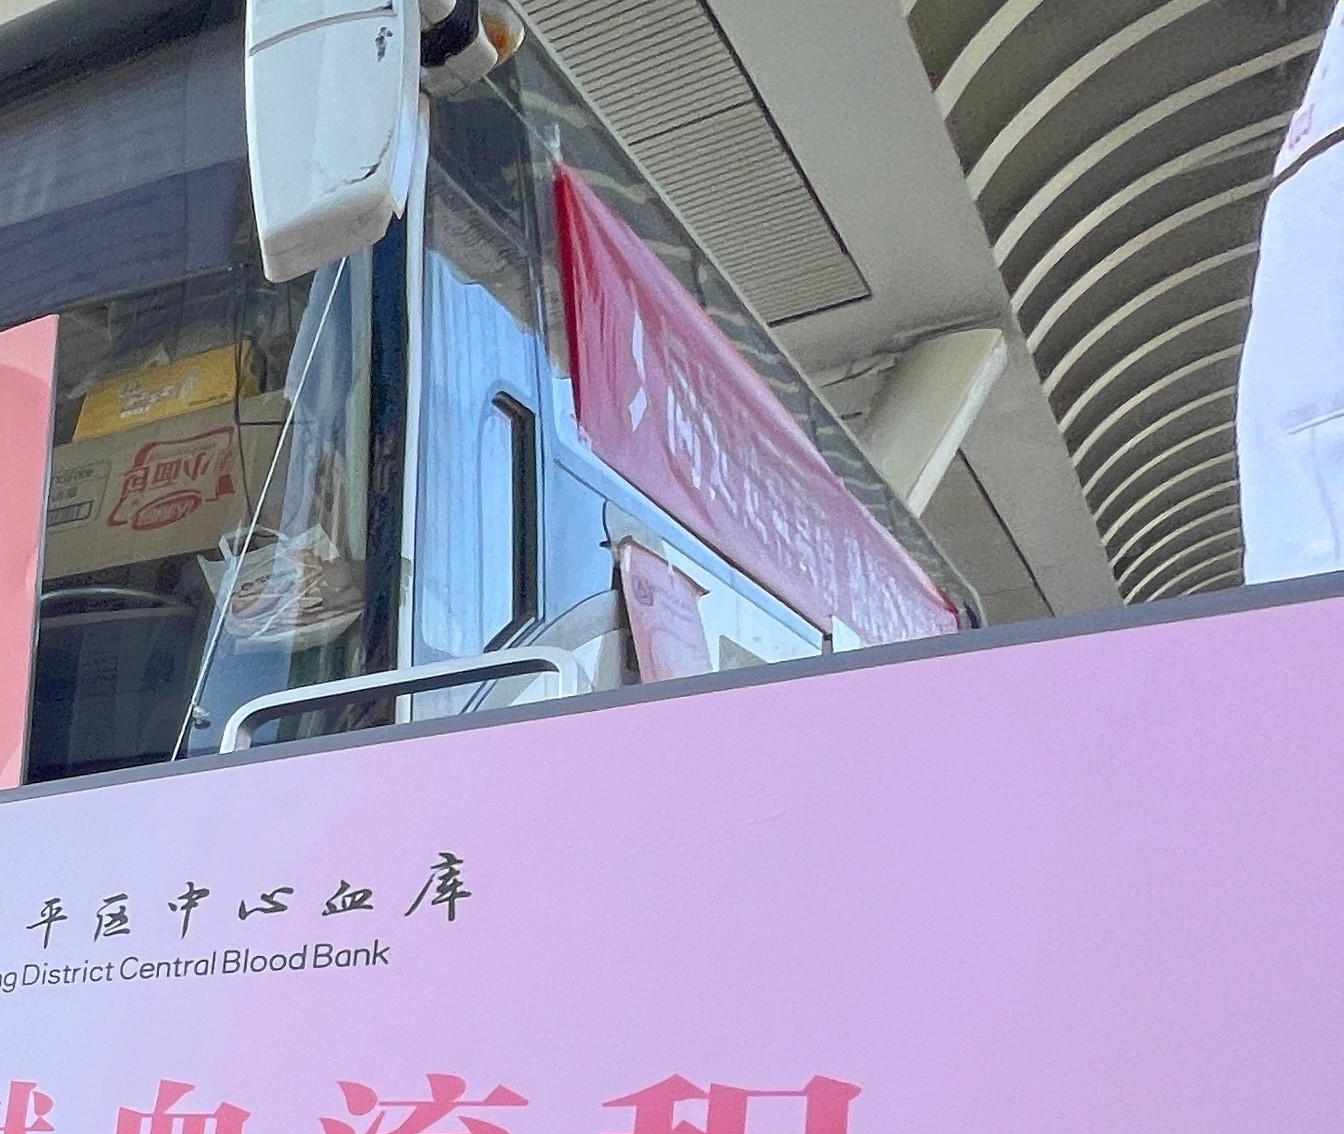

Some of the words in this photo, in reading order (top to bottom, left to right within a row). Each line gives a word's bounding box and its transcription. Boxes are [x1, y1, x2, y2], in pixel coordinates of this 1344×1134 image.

[22, 959, 114, 987] District
[119, 950, 217, 980] Central
[223, 944, 307, 974] Blood
[314, 938, 390, 969] Bank
